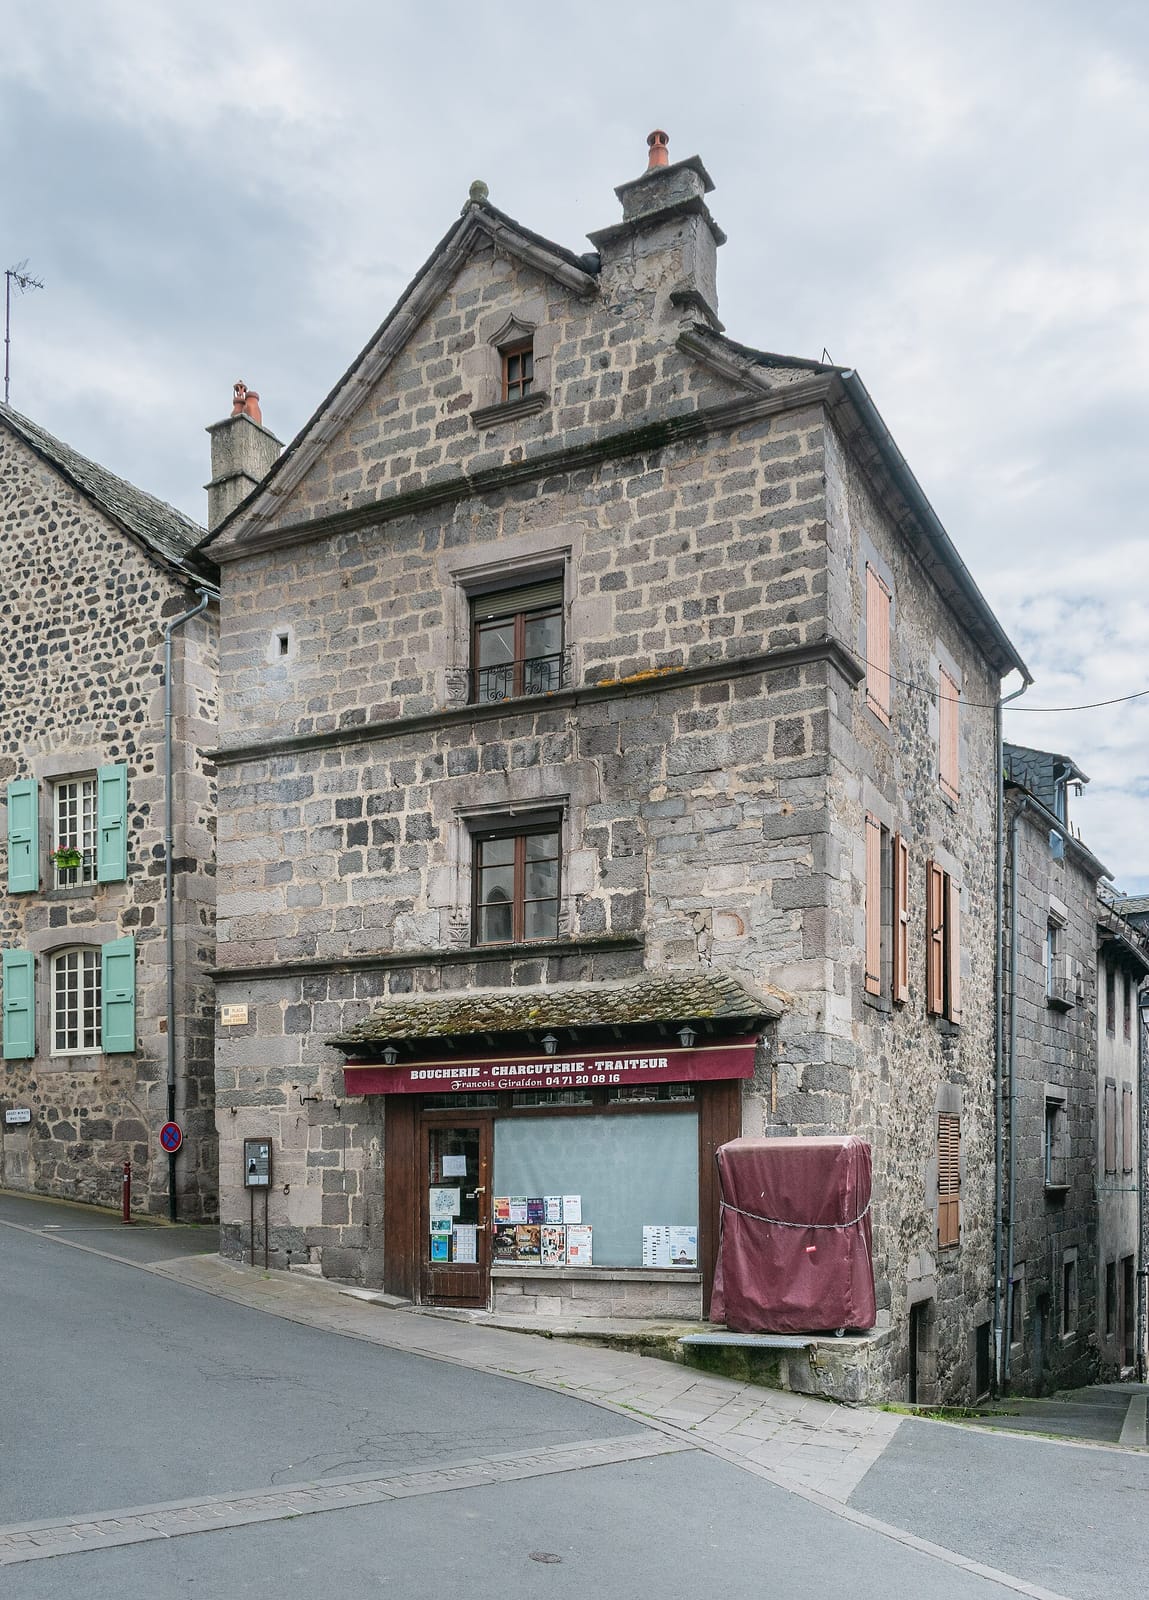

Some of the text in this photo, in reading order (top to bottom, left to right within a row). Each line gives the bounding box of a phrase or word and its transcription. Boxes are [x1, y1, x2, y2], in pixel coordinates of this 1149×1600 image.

[410, 1067, 480, 1079] BOUCHERIE
[491, 1062, 585, 1076] CHARCUTERIE
[595, 1058, 668, 1071] TRAITEUR
[546, 1076, 559, 1086] 04
[562, 1076, 572, 1085] 71
[576, 1075, 589, 1084] 20
[592, 1074, 605, 1083] 08
[609, 1073, 620, 1083] 16
